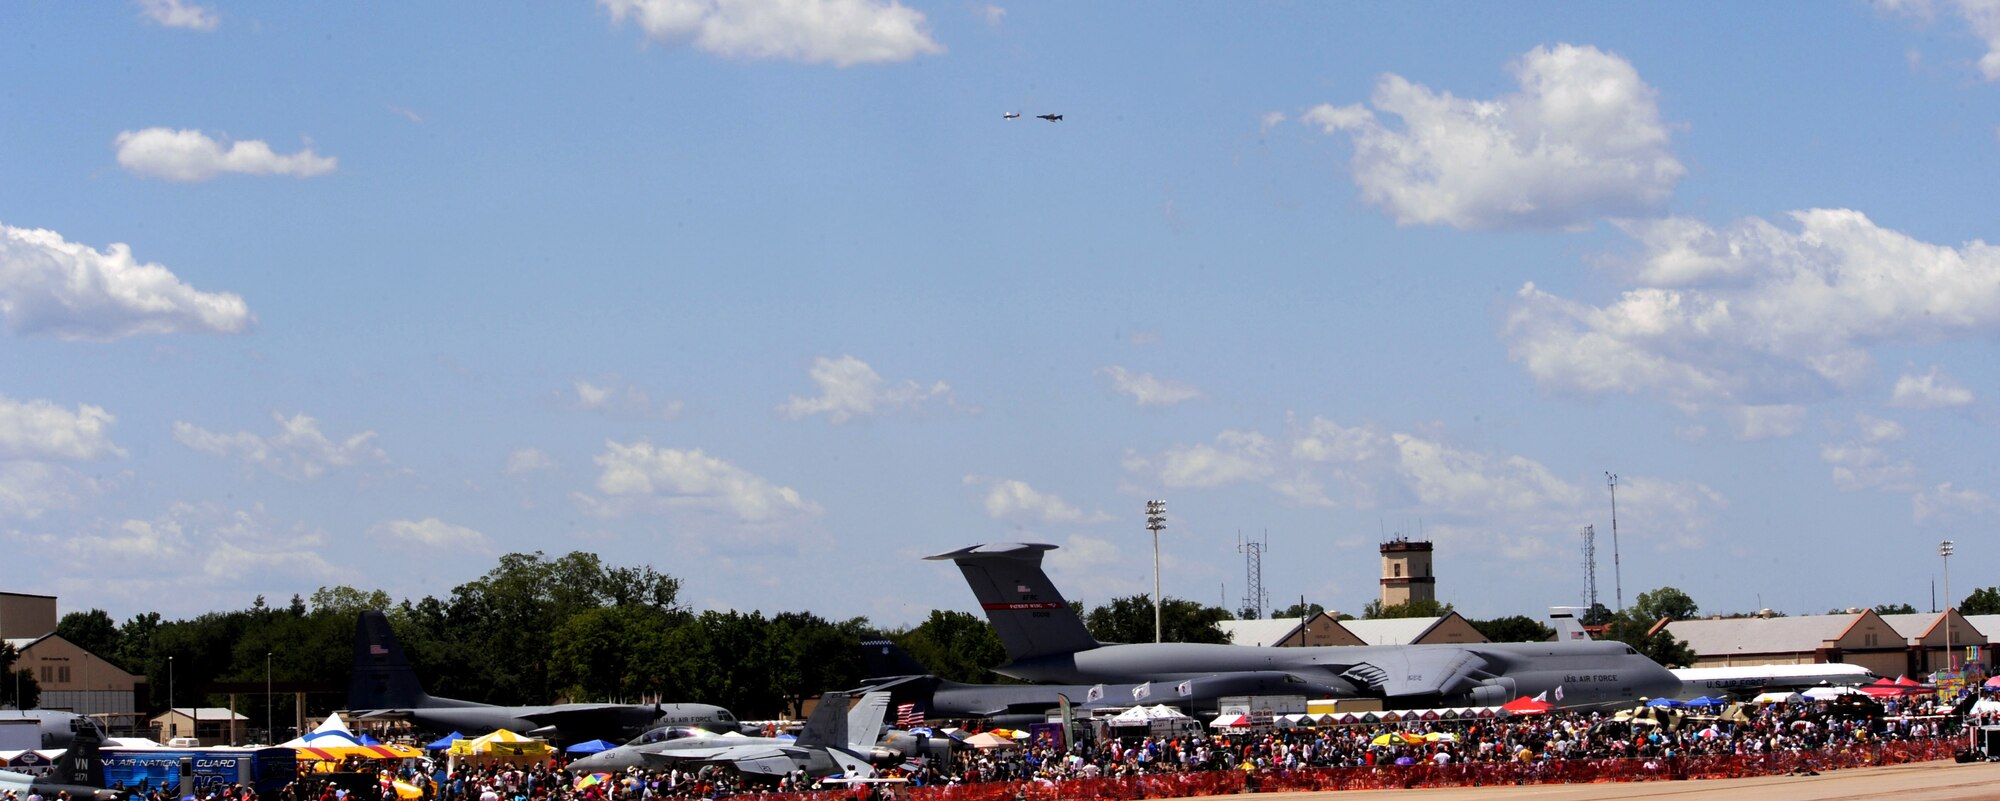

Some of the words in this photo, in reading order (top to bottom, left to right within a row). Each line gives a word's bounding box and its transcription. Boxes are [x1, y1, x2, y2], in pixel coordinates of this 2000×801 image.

[1593, 674, 1617, 682] FORCE
[1740, 678, 1767, 686] FORCE
[75, 758, 88, 770] VN
[119, 758, 136, 766] AIR
[196, 759, 235, 768] GUARD
